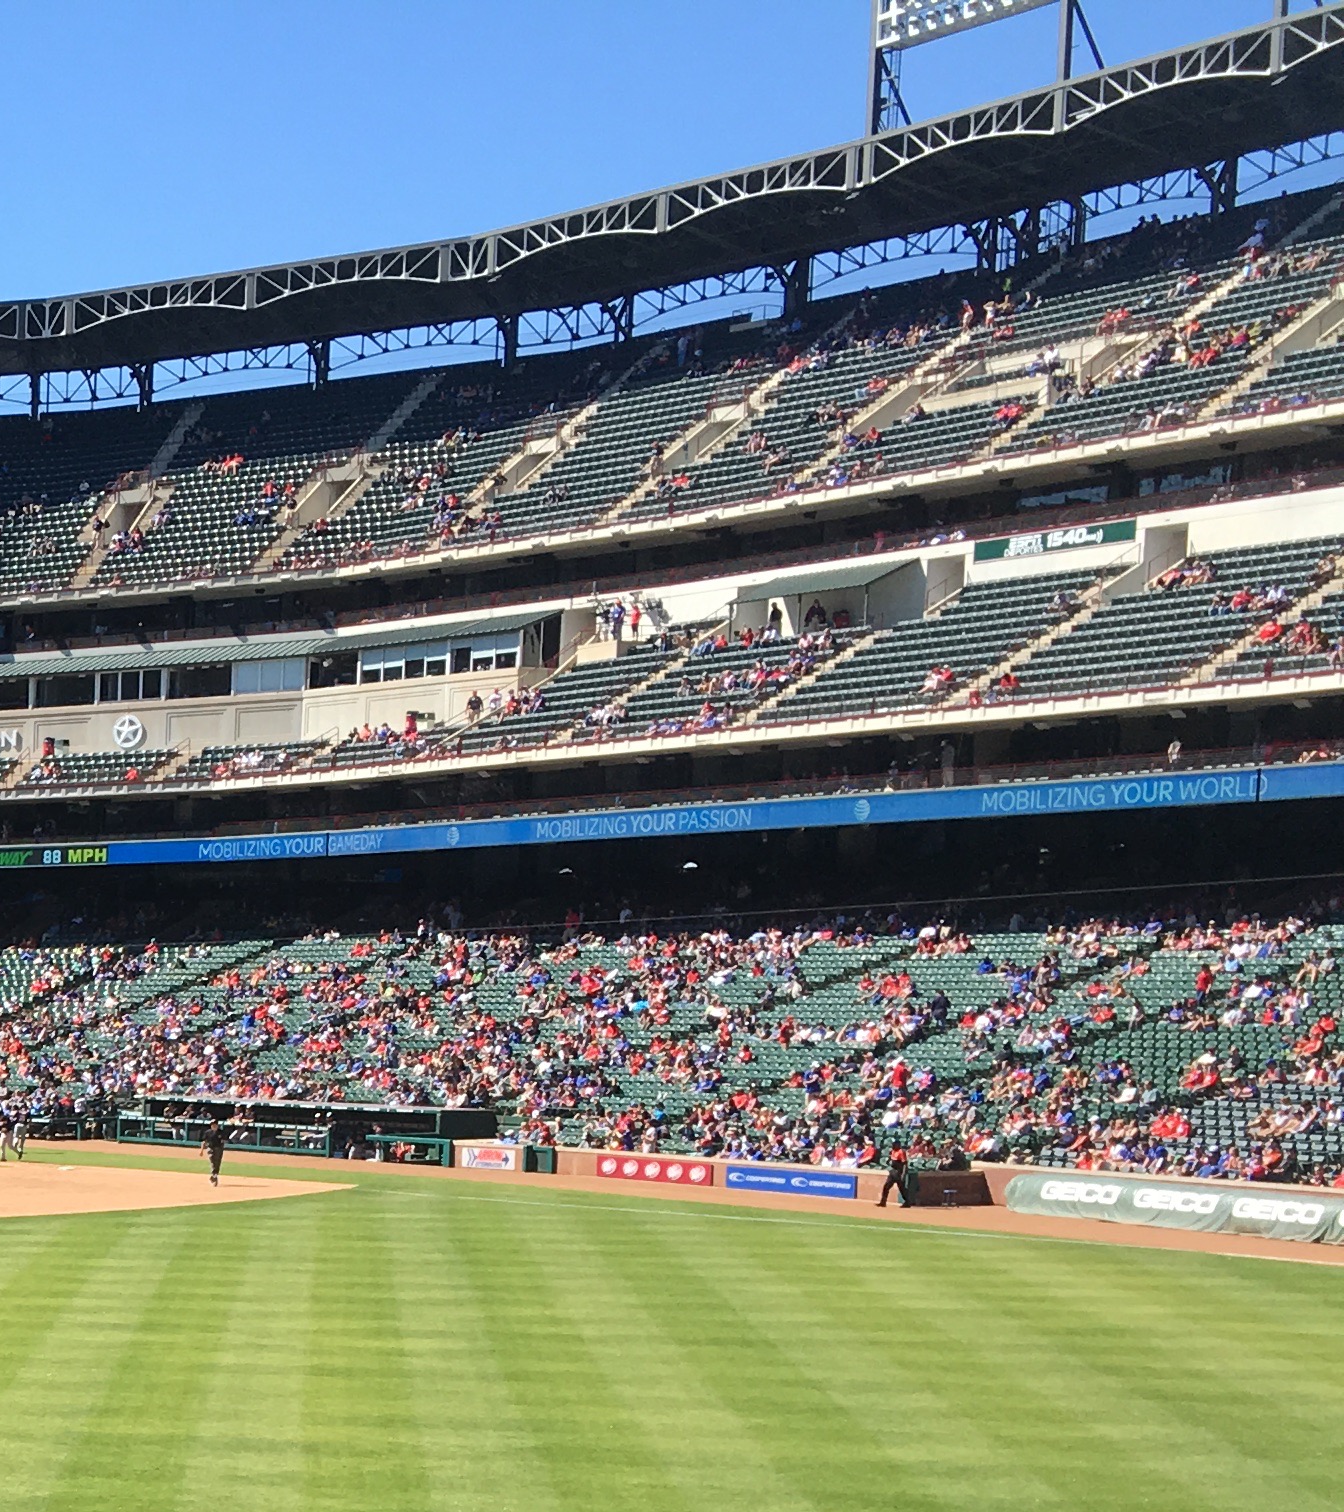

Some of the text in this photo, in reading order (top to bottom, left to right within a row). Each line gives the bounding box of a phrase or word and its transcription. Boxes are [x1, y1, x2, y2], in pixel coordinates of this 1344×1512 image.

[1009, 533, 1043, 549] ESPN
[1047, 528, 1087, 548] 1540
[981, 774, 1268, 812] MOBILIZING YOUR WORLD
[536, 808, 752, 839] MOBILIZING YOUR PASSION
[42, 848, 107, 864] 88 MPH
[198, 833, 384, 859] MOBILIZING YOUR GAMEDAY
[1040, 1180, 1122, 1206] GEICO
[1133, 1187, 1220, 1214] GEICO
[1232, 1197, 1326, 1225] GEICO
